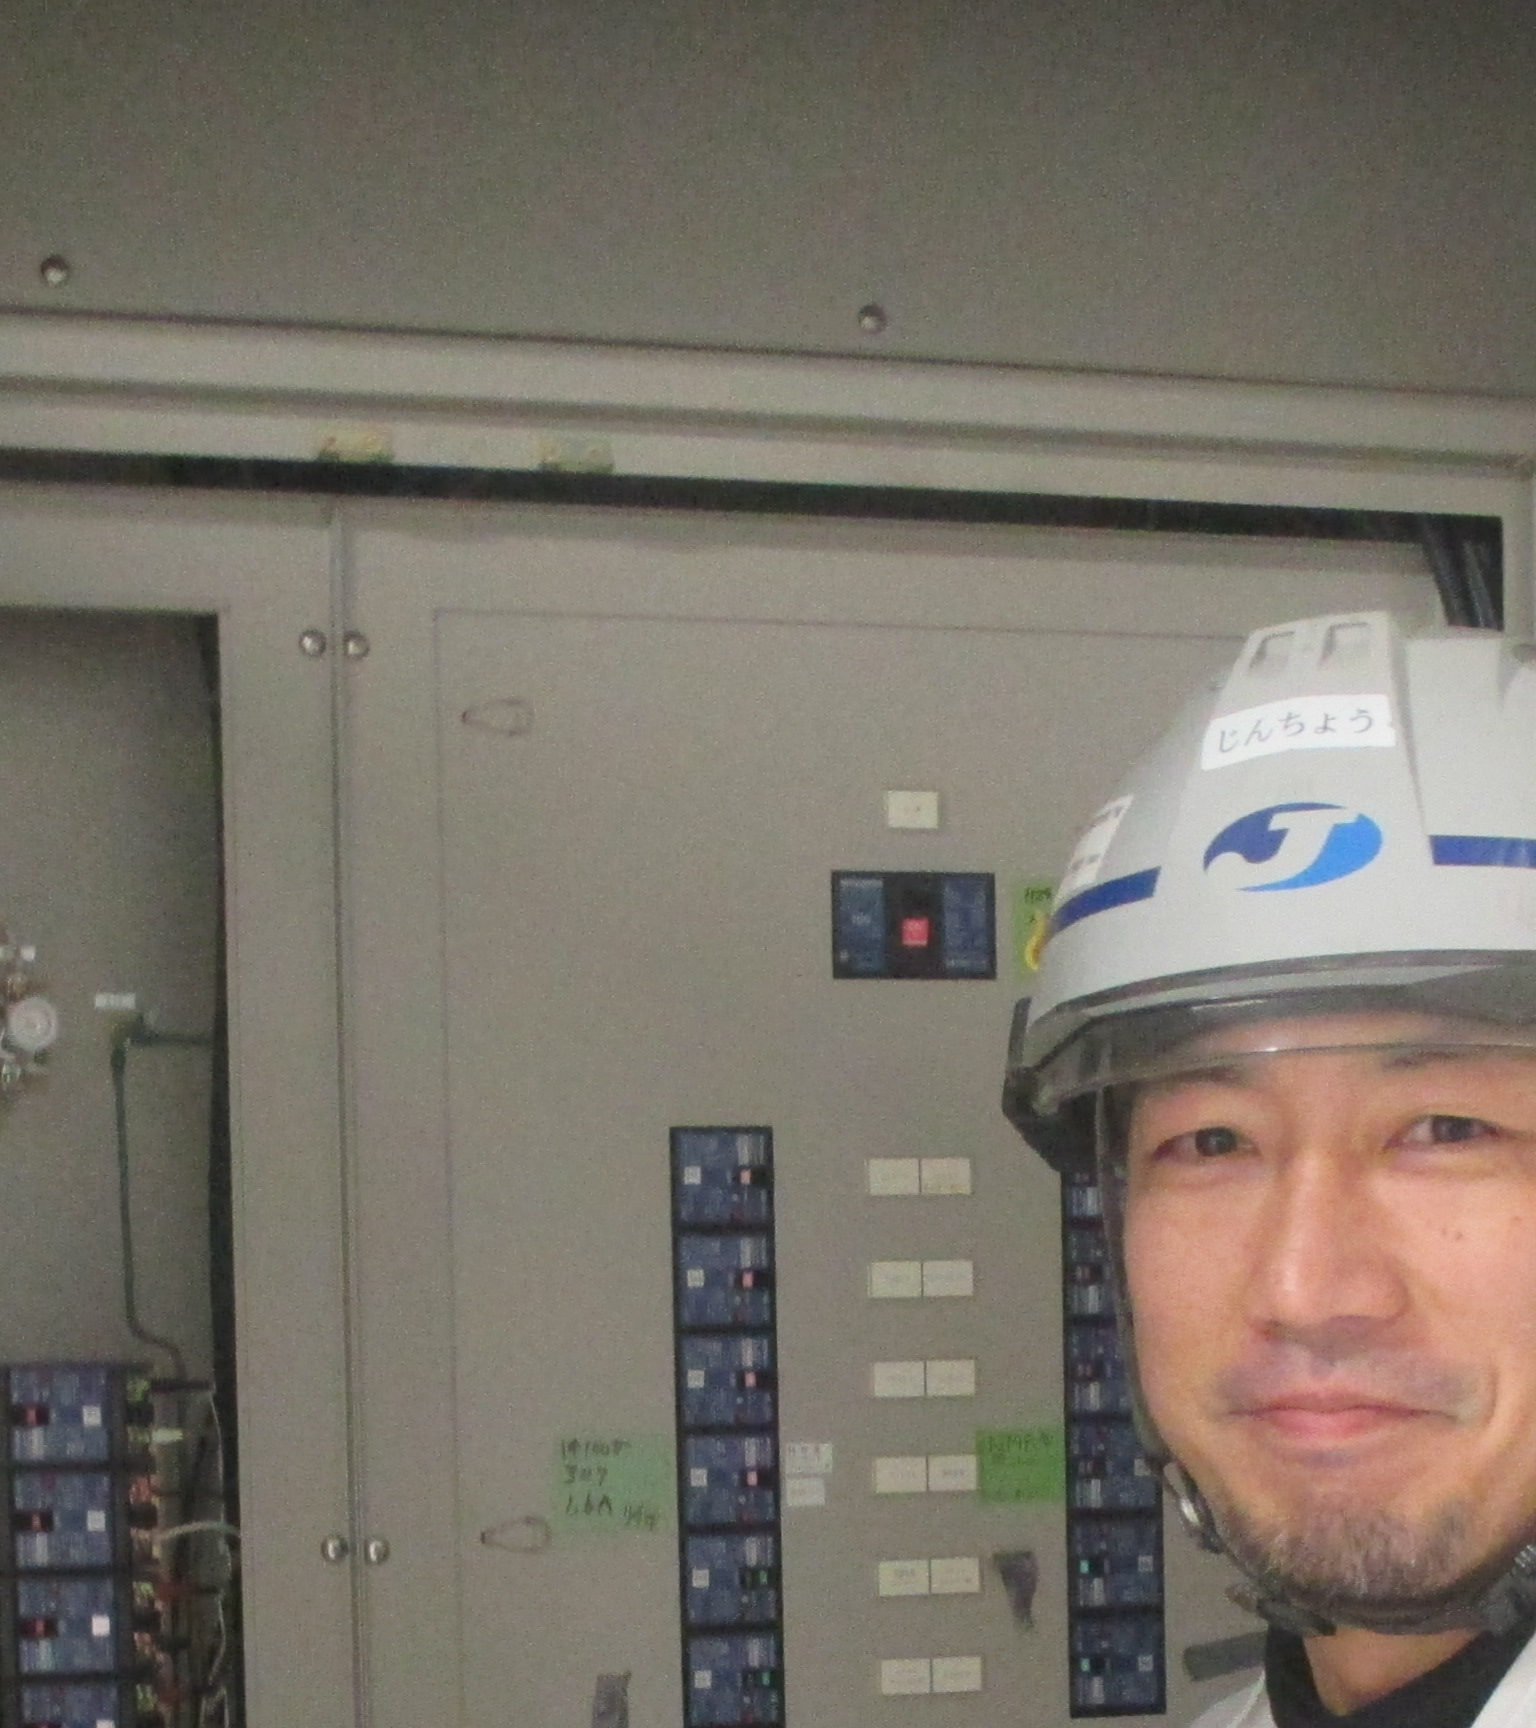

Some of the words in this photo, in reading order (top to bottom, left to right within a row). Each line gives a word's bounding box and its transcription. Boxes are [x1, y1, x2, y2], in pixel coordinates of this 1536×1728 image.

[1218, 708, 1374, 753] じんちょう
